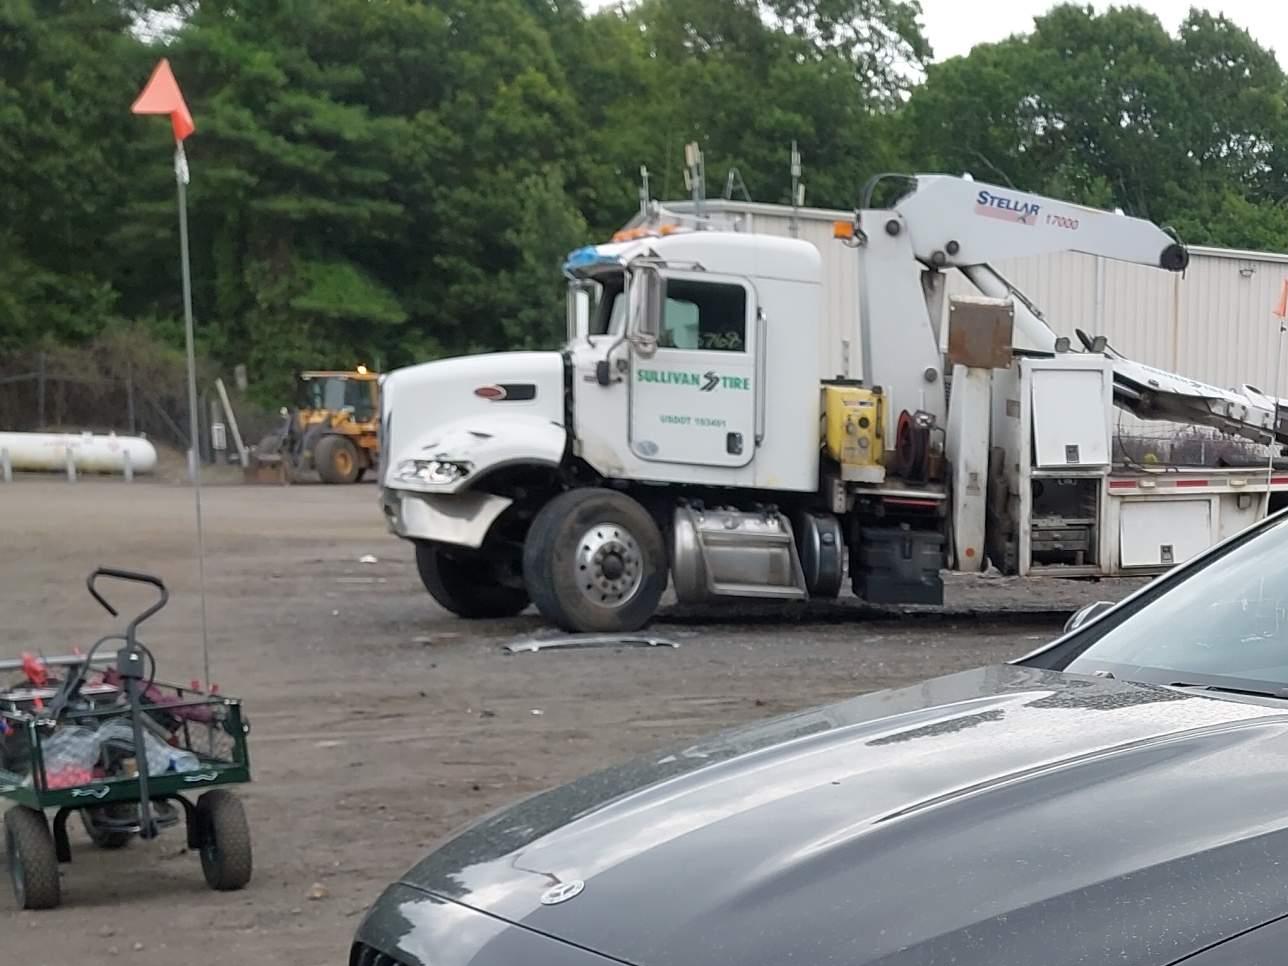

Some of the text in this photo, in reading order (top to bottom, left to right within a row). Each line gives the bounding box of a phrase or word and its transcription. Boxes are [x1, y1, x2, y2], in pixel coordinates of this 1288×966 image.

[977, 191, 1040, 216] STELLAR
[637, 369, 751, 391] SULLIVAN TIRE
